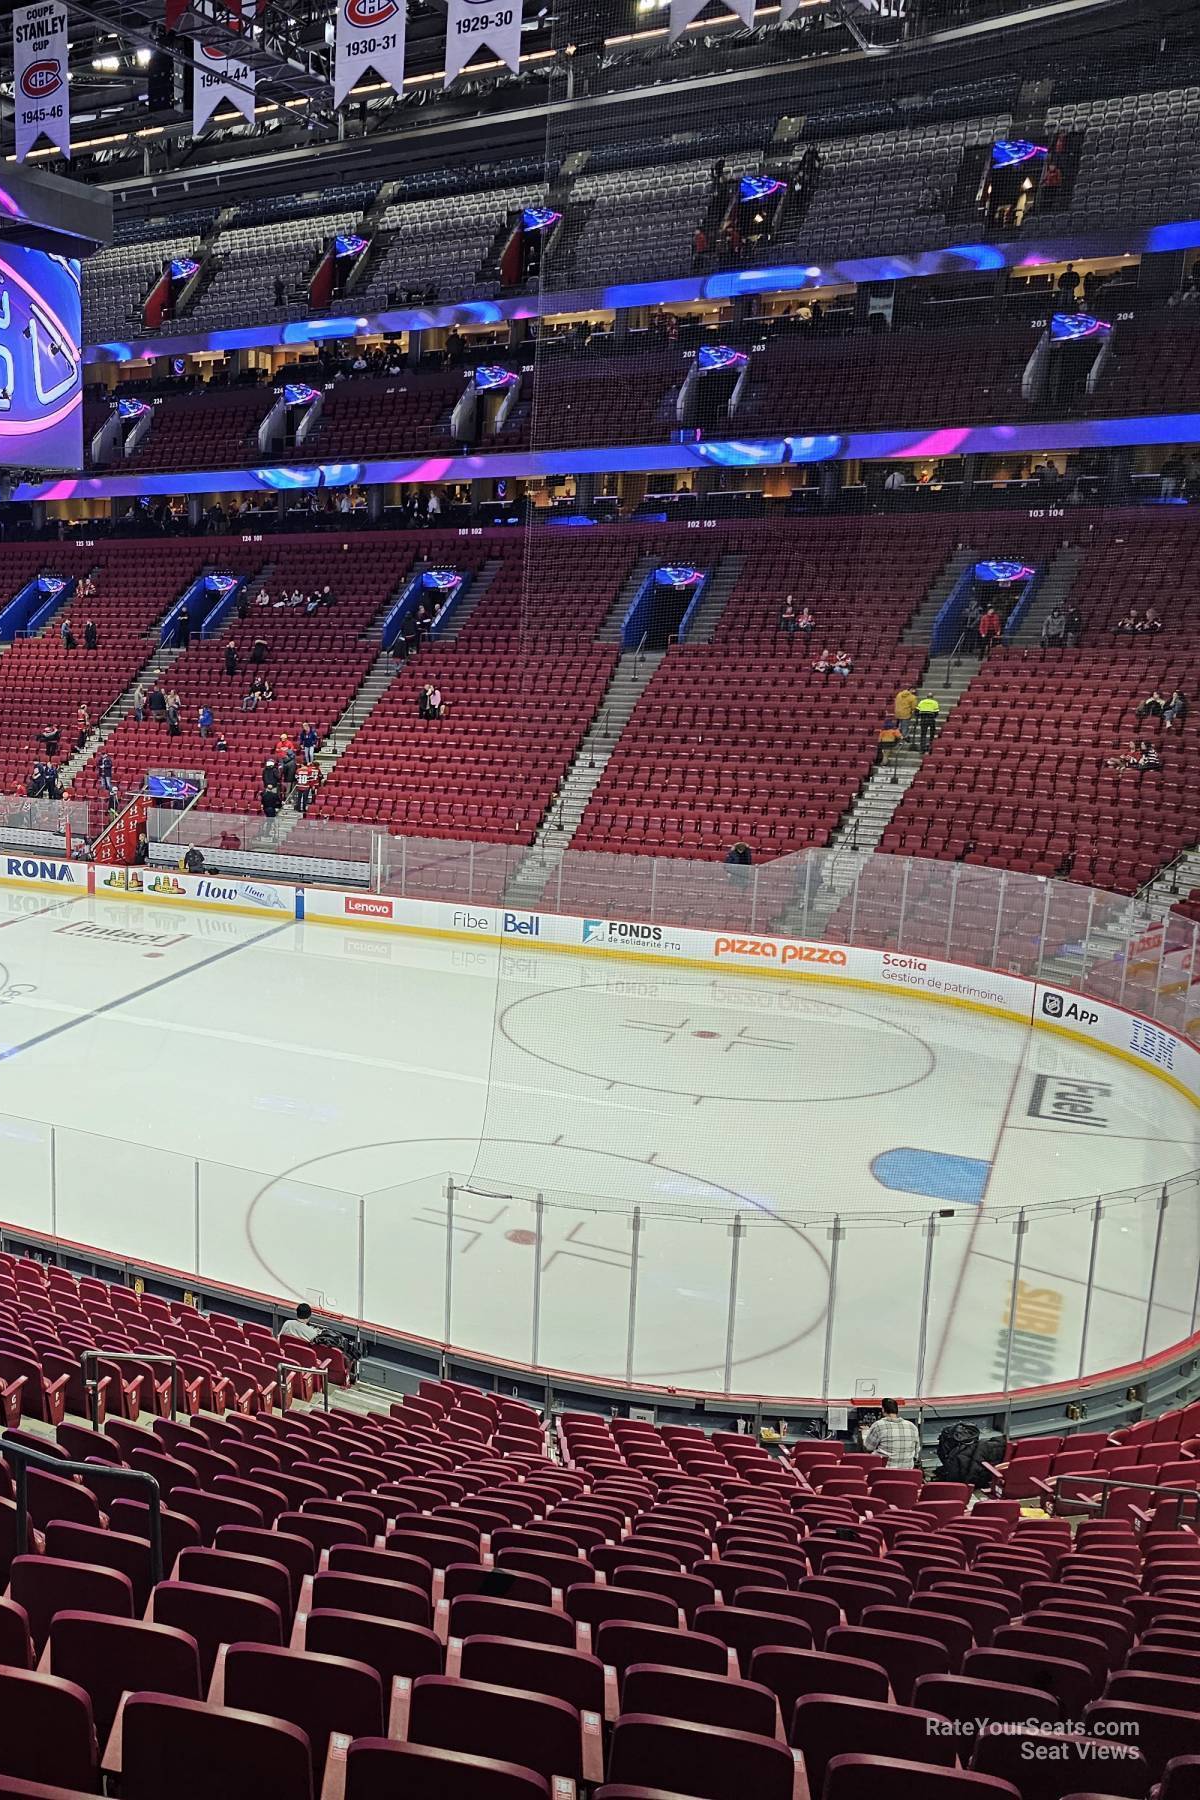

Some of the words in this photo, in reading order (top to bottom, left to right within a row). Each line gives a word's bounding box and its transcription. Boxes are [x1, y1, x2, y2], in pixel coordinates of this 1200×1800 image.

[27, 5, 54, 21] COUPE
[455, 10, 513, 35] 1929-30
[16, 14, 66, 43] STANLEY
[32, 39, 49, 52] CUP
[346, 34, 397, 57] 1930-31
[22, 104, 63, 124] 1945-46
[1031, 320, 1047, 328] 203
[1116, 312, 1134, 320] 204
[1029, 510, 1044, 518] 103
[1048, 509, 1064, 517] 104
[458, 528, 468, 536] 101
[471, 527, 482, 535] 102
[7, 858, 74, 882] RONA
[197, 880, 238, 900] flow
[348, 900, 389, 914] Lenovo
[453, 912, 488, 930] Fibe
[504, 913, 539, 935] Bell
[608, 922, 662, 941] FONDS
[76, 924, 166, 943] intact
[620, 938, 662, 949] solidarité
[714, 937, 776, 957] pizza
[781, 945, 847, 966] pizza
[882, 953, 927, 971] Scotia
[881, 969, 925, 986] Gestion
[927, 978, 942, 989] de
[1129, 1019, 1176, 1070] IBM
[11, 1394, 17, 1403] G
[55, 1391, 60, 1401] F
